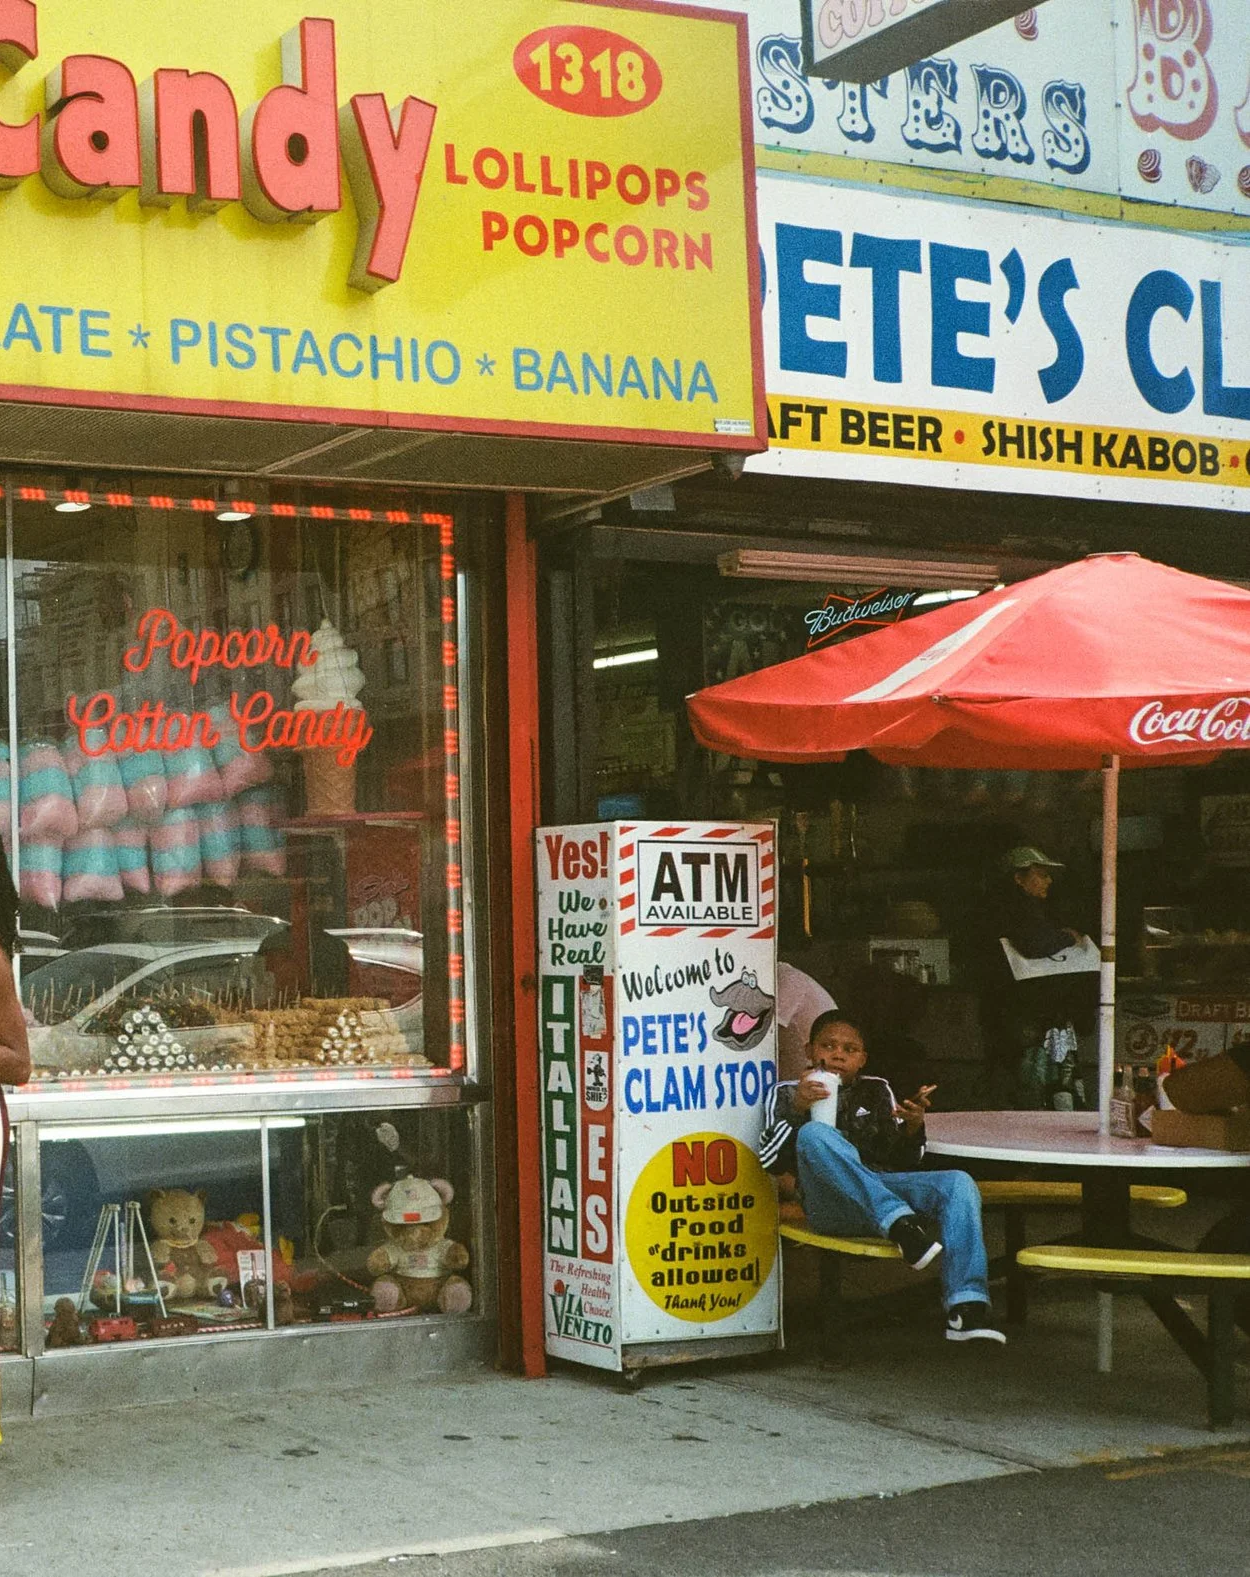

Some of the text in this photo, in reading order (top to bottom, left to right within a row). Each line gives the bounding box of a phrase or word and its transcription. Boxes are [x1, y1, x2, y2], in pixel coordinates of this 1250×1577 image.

[528, 42, 647, 103] 1318
[756, 33, 1092, 175] STERS
[444, 143, 710, 211] LOLLIPOPS
[481, 210, 713, 271] POPCORN
[759, 222, 1250, 420] ETE'S CL
[170, 318, 461, 385] PISTACHIO
[512, 347, 718, 403] BANANA
[840, 408, 943, 453] BEER
[981, 420, 1083, 465] SHISH
[1092, 432, 1220, 477] KABOB
[803, 592, 917, 635] Budweiser
[123, 608, 319, 686] Popcorn
[68, 690, 374, 768] Cotton Candy
[544, 831, 611, 880] Yes!
[650, 851, 749, 903] ATM
[558, 889, 595, 915] We
[646, 905, 753, 921] AVAILABLE
[548, 917, 608, 941] Have
[551, 941, 606, 967] Real
[622, 947, 735, 1003] Welcome to
[622, 1011, 708, 1058] PETE'S
[624, 1059, 777, 1115] CLAM STOP
[546, 983, 576, 1252] ITALIAN
[672, 1138, 738, 1188] NO
[651, 1191, 755, 1214] Outside
[549, 1259, 612, 1286] The Refreshing
[648, 1240, 747, 1262] or drinks
[580, 1282, 611, 1303] Healthy
[583, 1300, 615, 1319] Choice!
[664, 1292, 743, 1312] Thank You!
